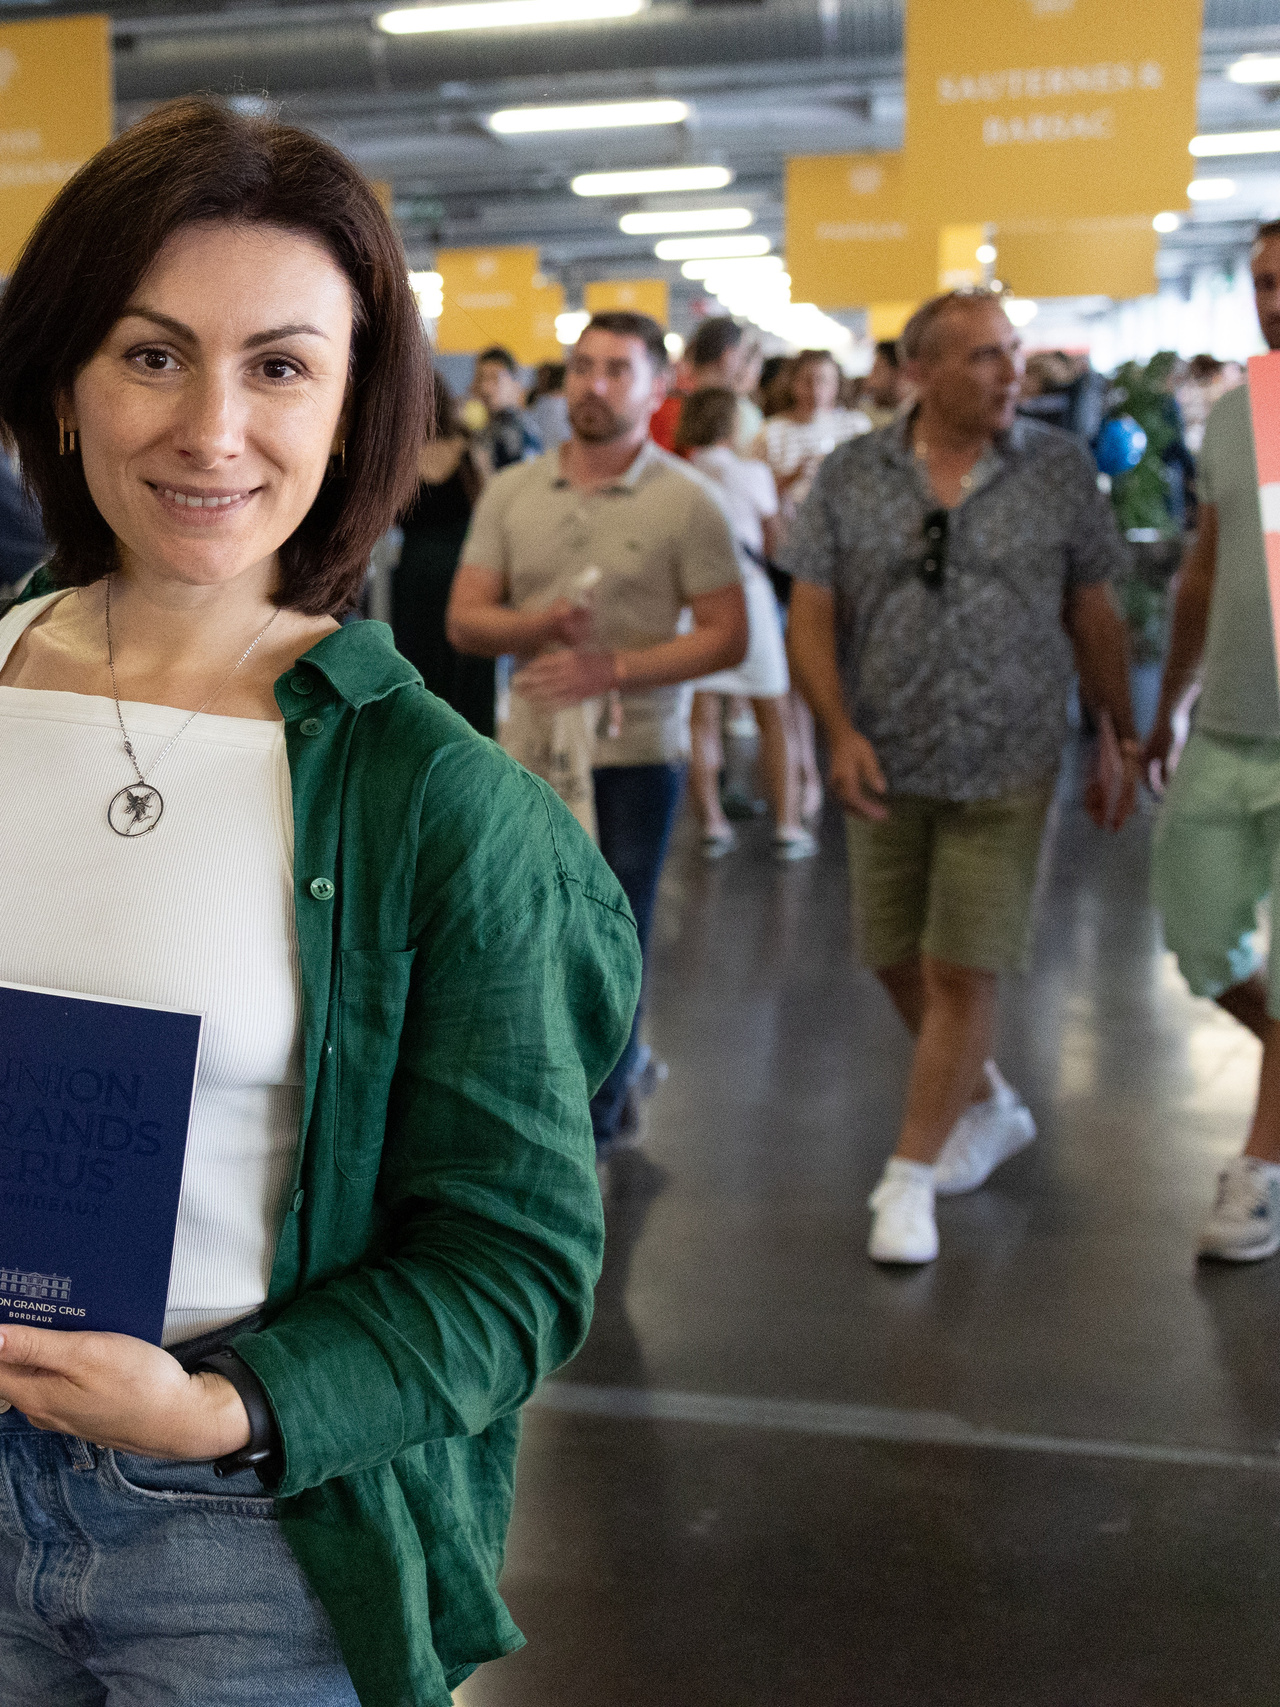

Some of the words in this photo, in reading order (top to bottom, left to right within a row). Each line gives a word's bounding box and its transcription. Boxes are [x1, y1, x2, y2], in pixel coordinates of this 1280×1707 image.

[13, 1300, 57, 1313] GRANDS
[59, 1306, 86, 1317] CRUS
[8, 1311, 53, 1323] BORDEAUX
